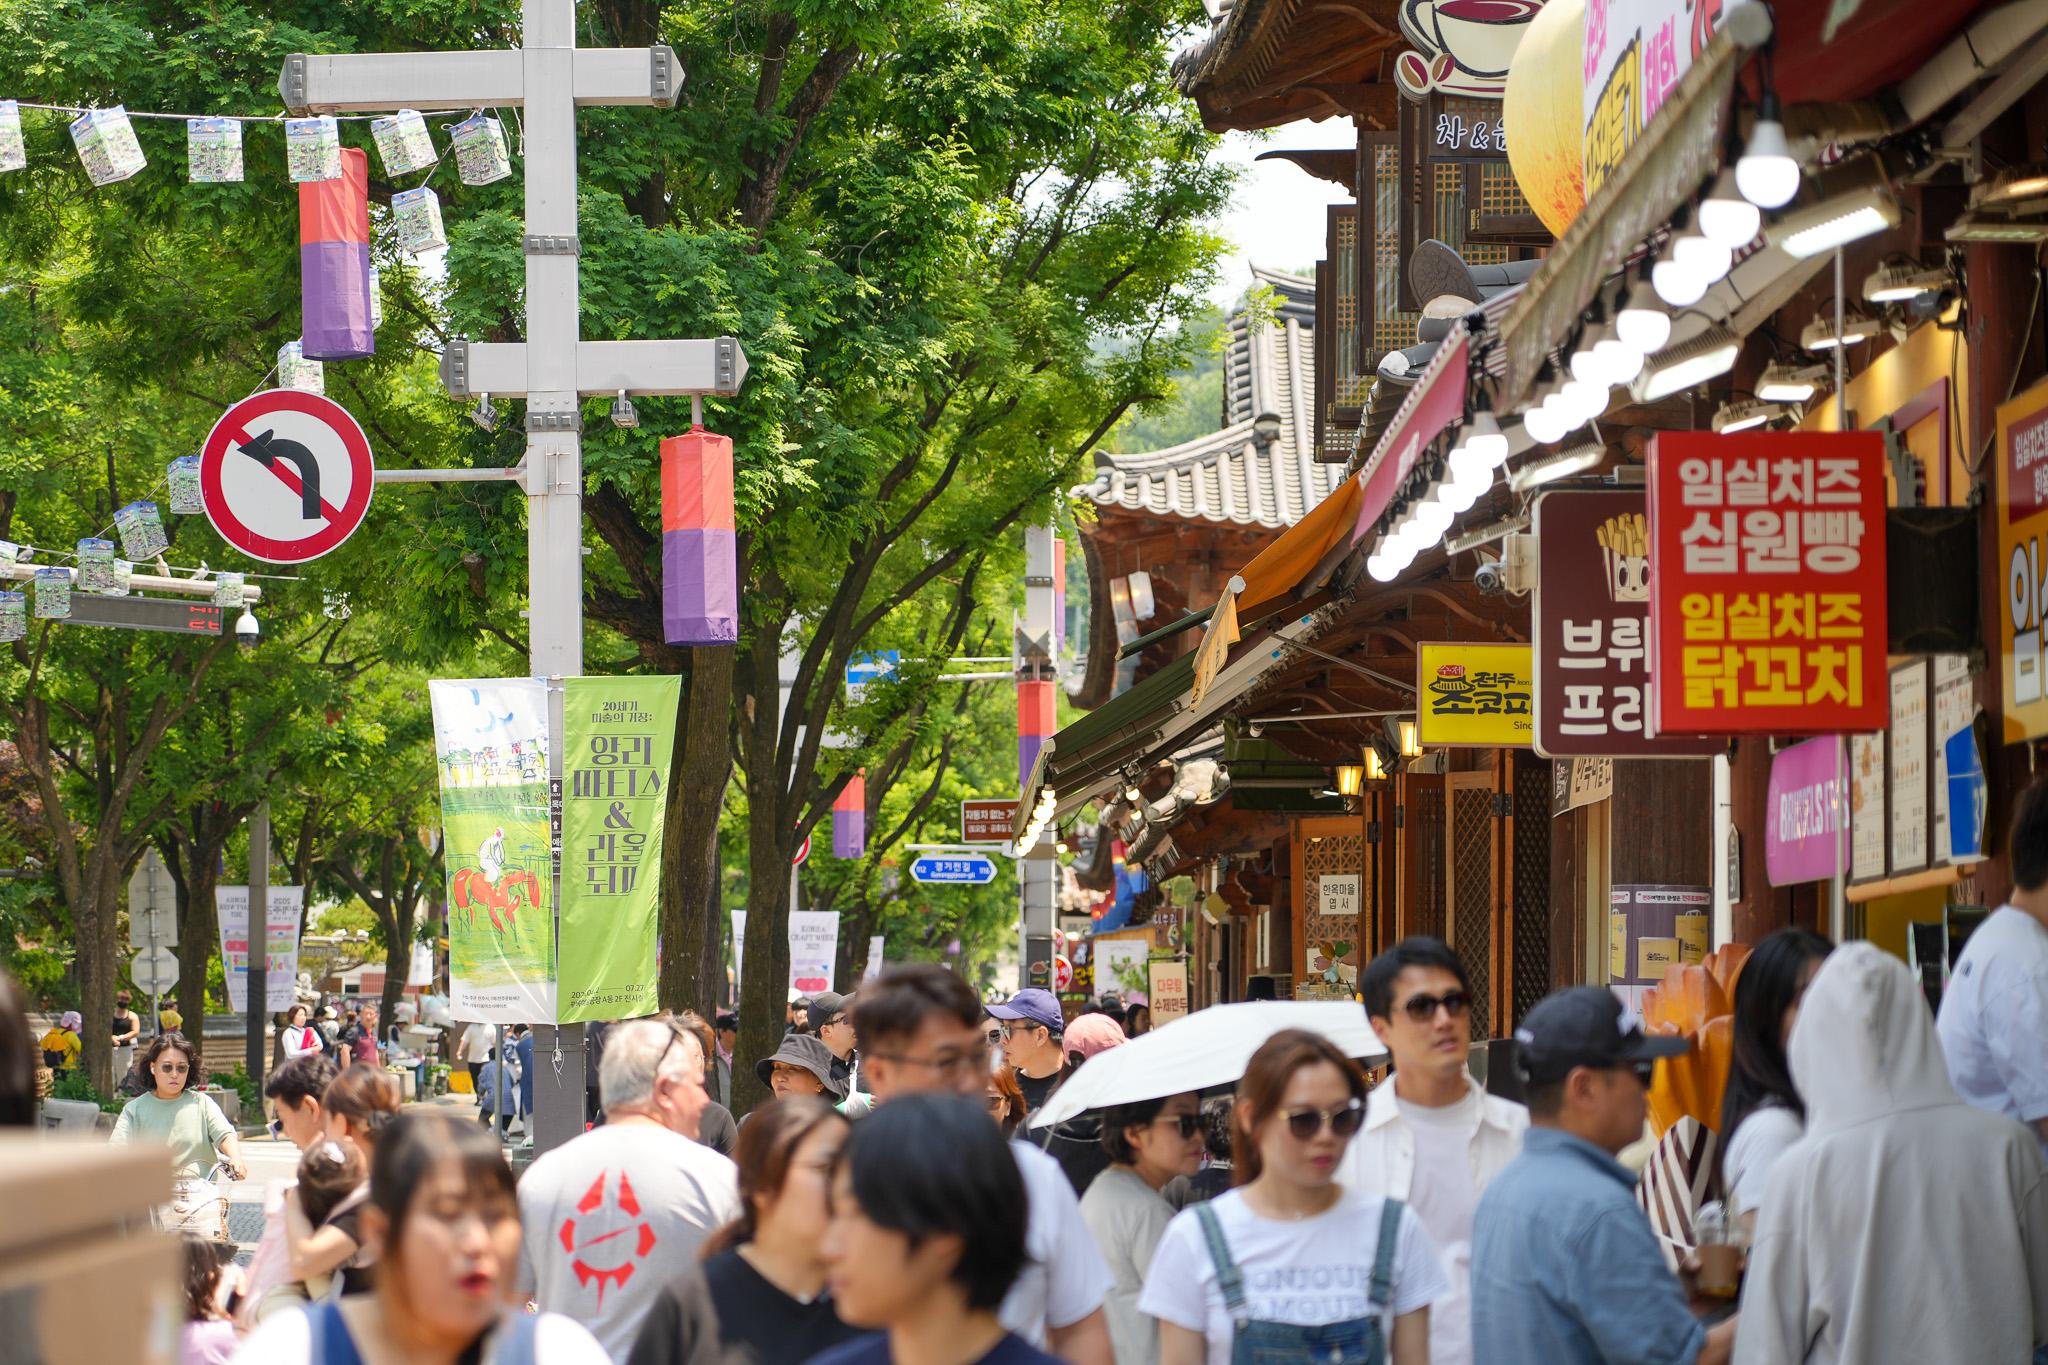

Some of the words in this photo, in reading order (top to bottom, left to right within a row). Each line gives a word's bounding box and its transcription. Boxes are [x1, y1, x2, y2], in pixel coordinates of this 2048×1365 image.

[2015, 418, 2048, 470] 임실치즈
[1678, 457, 1862, 506] 임실치즈
[1680, 510, 1865, 574] 십원빵
[1680, 592, 1864, 641] 임실치즈
[2009, 534, 2048, 708] 임
[1558, 616, 1652, 674] 브뤼
[1471, 671, 1516, 689] 전주
[1682, 644, 1863, 709] 닭꼬치
[591, 713, 624, 723] 미술의
[629, 713, 653, 723] 거장:
[602, 700, 638, 712] 20세기
[1559, 682, 1655, 740] 프리
[1513, 721, 1532, 730] Sinc
[590, 736, 652, 766] 앙리
[573, 769, 662, 797] 마티스
[604, 801, 635, 829] &
[587, 833, 647, 862] 라울
[1322, 883, 1355, 896] 한옥마을
[1153, 999, 1187, 1012] 수제만두
